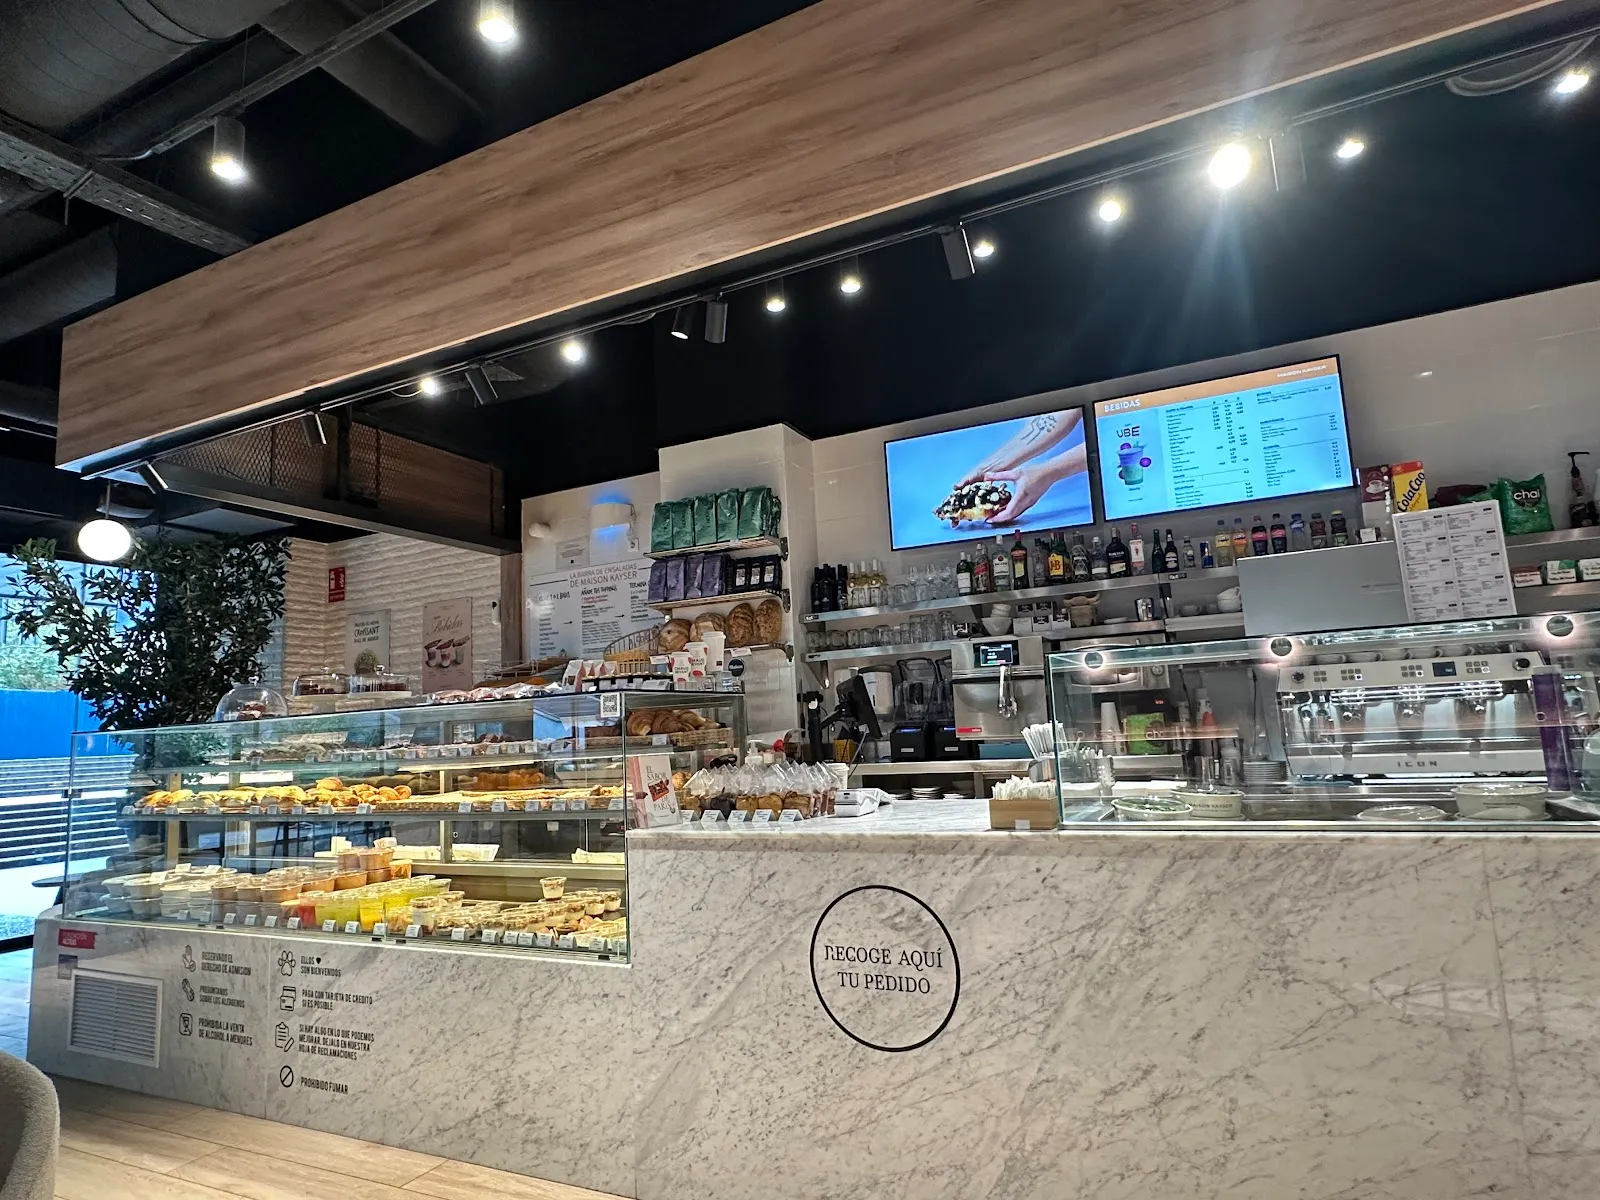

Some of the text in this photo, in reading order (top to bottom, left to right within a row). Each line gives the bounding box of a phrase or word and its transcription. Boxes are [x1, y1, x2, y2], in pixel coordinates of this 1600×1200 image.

[1104, 399, 1141, 412] BEBIDAS
[1116, 426, 1140, 438] UBE
[1397, 472, 1425, 512] ColaCao
[1514, 488, 1540, 500] chai
[577, 570, 595, 578] BARRA
[604, 563, 637, 573] ENSALADAS
[570, 571, 637, 588] DE MAISON KAYSER
[1398, 760, 1438, 768] ICON
[301, 956, 314, 965] ELLOS
[824, 945, 943, 971] RECOGE AQUÍ
[301, 966, 341, 977] SON BIENVENIDOS
[837, 972, 931, 994] TU PEDIDO
[302, 989, 313, 998] PAGA
[315, 990, 324, 999] CON
[325, 992, 344, 1001] TARJETA
[345, 993, 351, 1002] DE
[314, 1001, 333, 1010] POSIBLE
[230, 1022, 244, 1033] VENTA
[315, 1026, 326, 1035] ALGO
[328, 1027, 333, 1036] EN
[335, 1028, 340, 1037] LO
[341, 1029, 350, 1038] QUE
[351, 1031, 374, 1042] PODEMOS
[199, 1029, 204, 1038] DE
[230, 1034, 252, 1046] MENORES
[341, 1040, 346, 1048] EN
[348, 1041, 370, 1052] NUESTRA
[311, 1046, 316, 1054] DE
[318, 1047, 357, 1060] RECLAMACIONES
[301, 1077, 348, 1094] PROHIBIDO FUMAR
